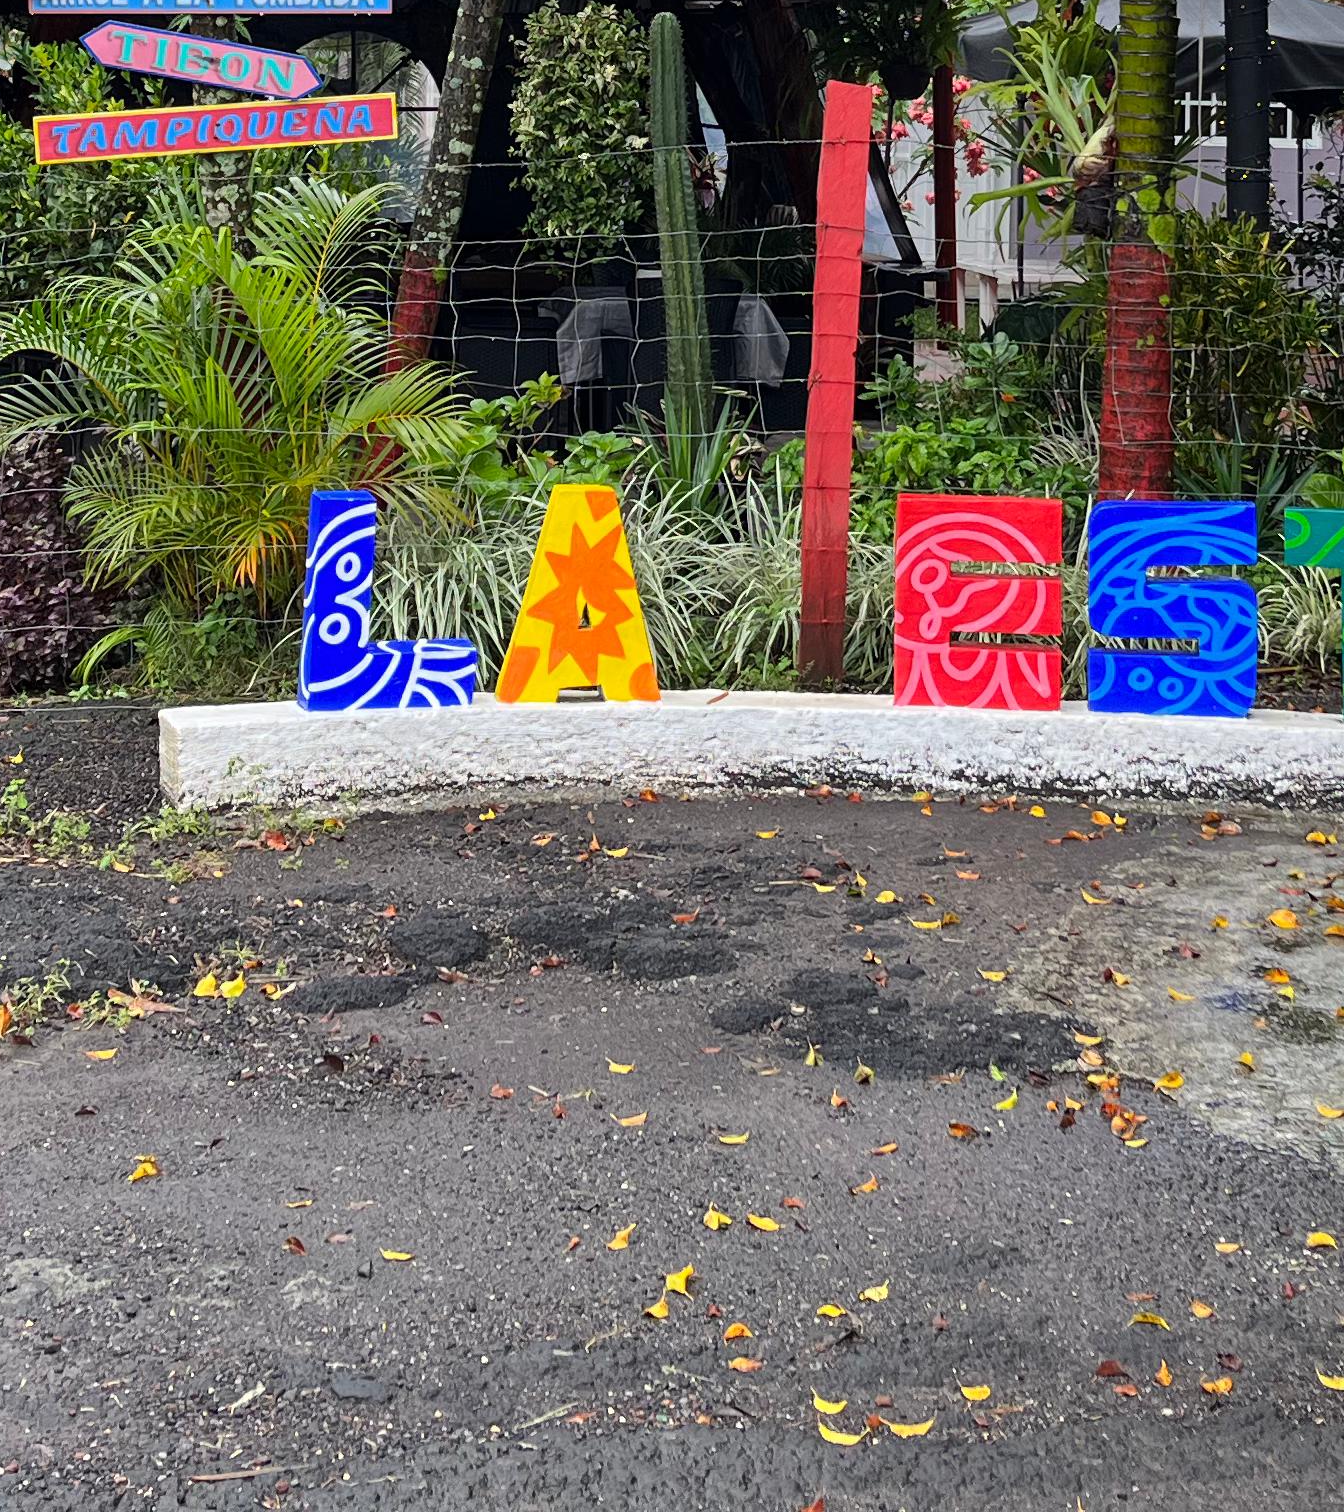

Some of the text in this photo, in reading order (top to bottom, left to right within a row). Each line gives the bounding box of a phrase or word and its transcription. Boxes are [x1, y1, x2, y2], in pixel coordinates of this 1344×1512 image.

[110, 30, 297, 93] TIBON
[52, 103, 373, 154] TAMPIQUEÑA
[298, 484, 659, 712] LA
